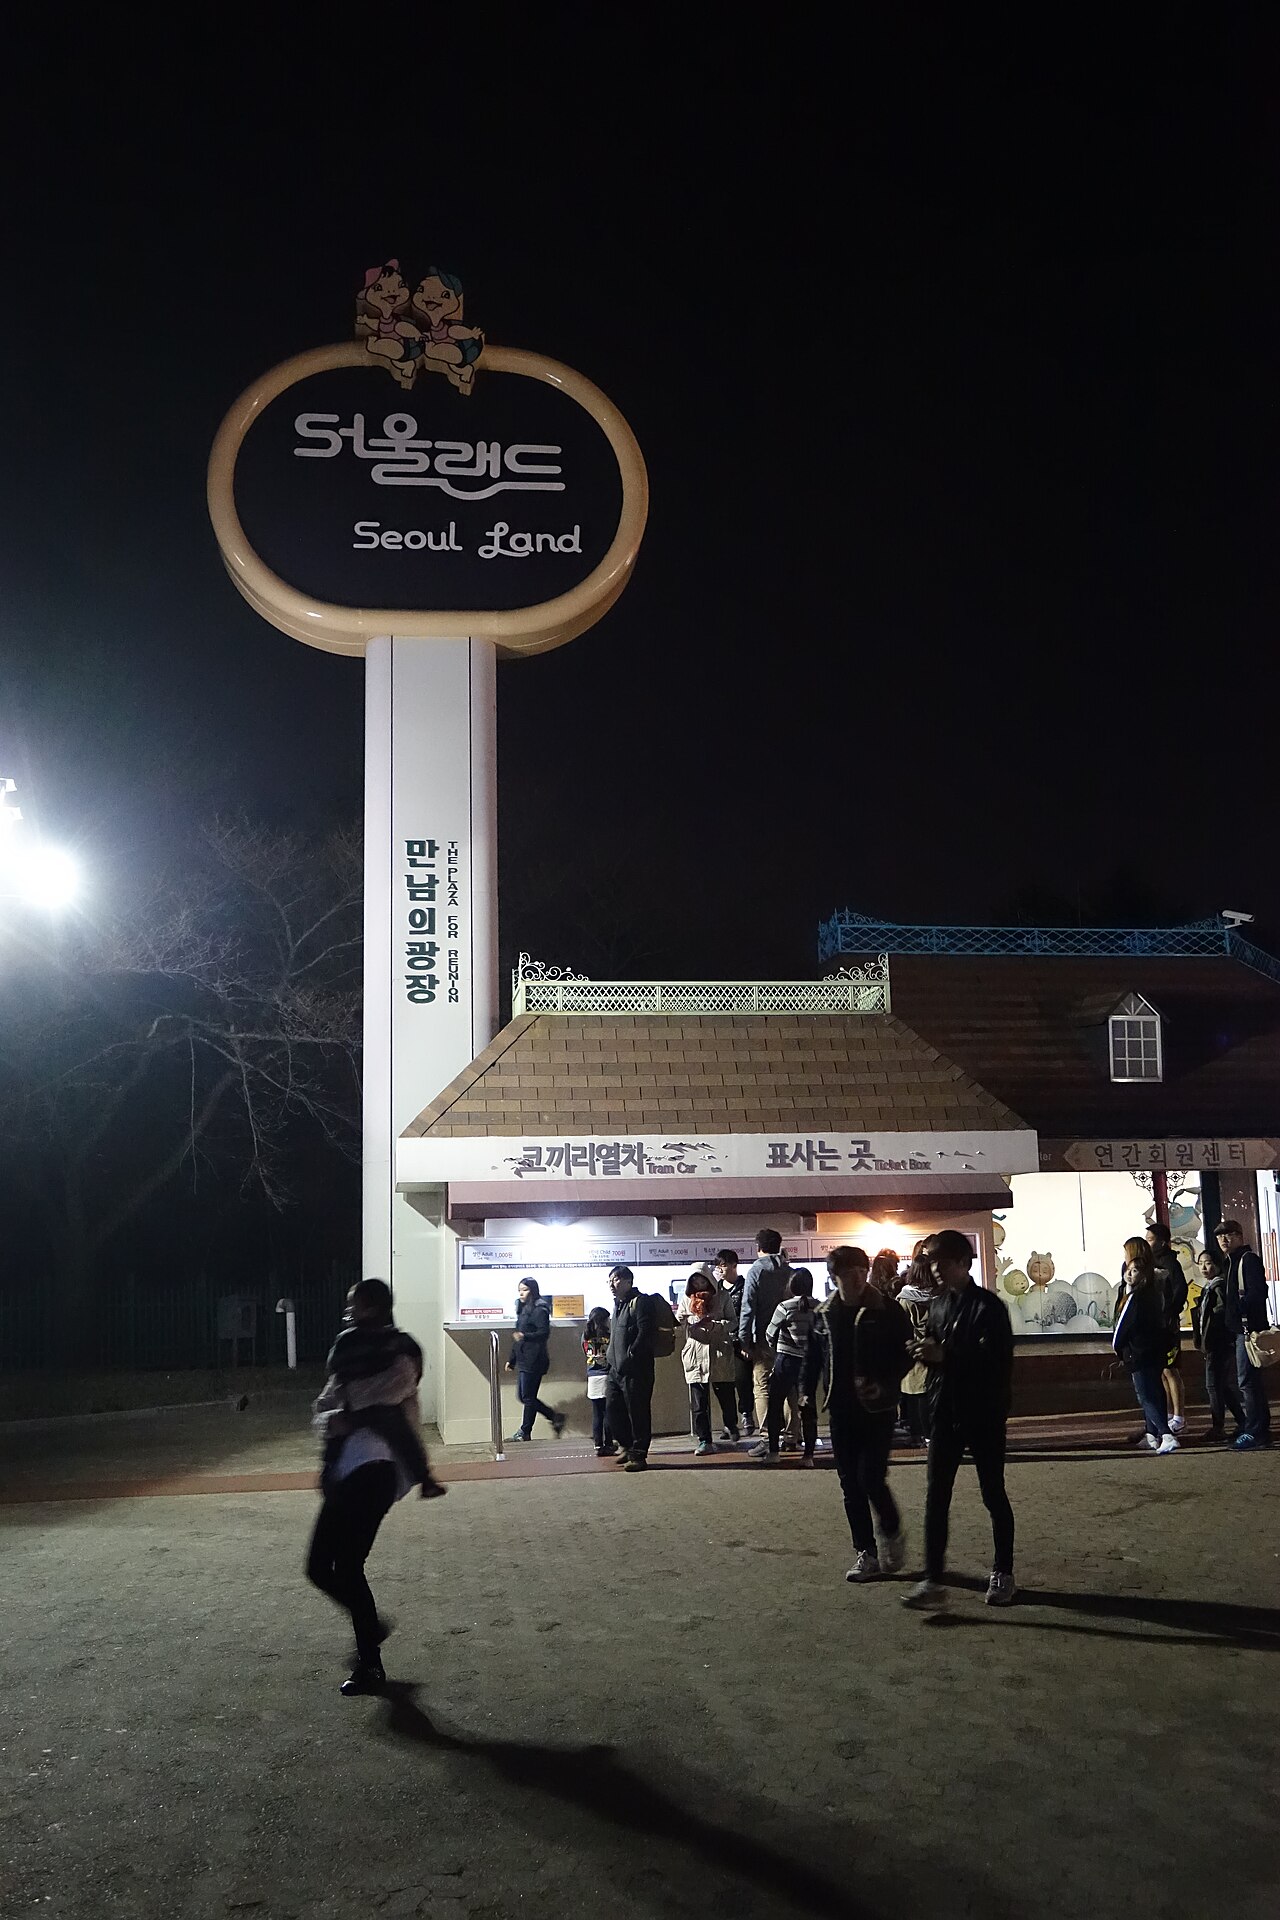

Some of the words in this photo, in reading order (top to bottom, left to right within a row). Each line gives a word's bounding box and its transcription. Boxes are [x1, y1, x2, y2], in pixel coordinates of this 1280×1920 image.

[293, 412, 566, 501] 서울랜드
[352, 521, 463, 551] Seoul
[477, 521, 583, 560] Land
[447, 841, 459, 865] THE
[447, 867, 459, 907] PLAZA
[447, 915, 459, 939] FOR
[448, 949, 459, 1003] REUNION
[518, 1141, 648, 1177] 코끼리열차
[646, 1162, 675, 1175] Tram
[677, 1162, 698, 1175] Car
[848, 1139, 876, 1172] 곳
[872, 1159, 908, 1172] Ticket
[908, 1158, 932, 1171] Box
